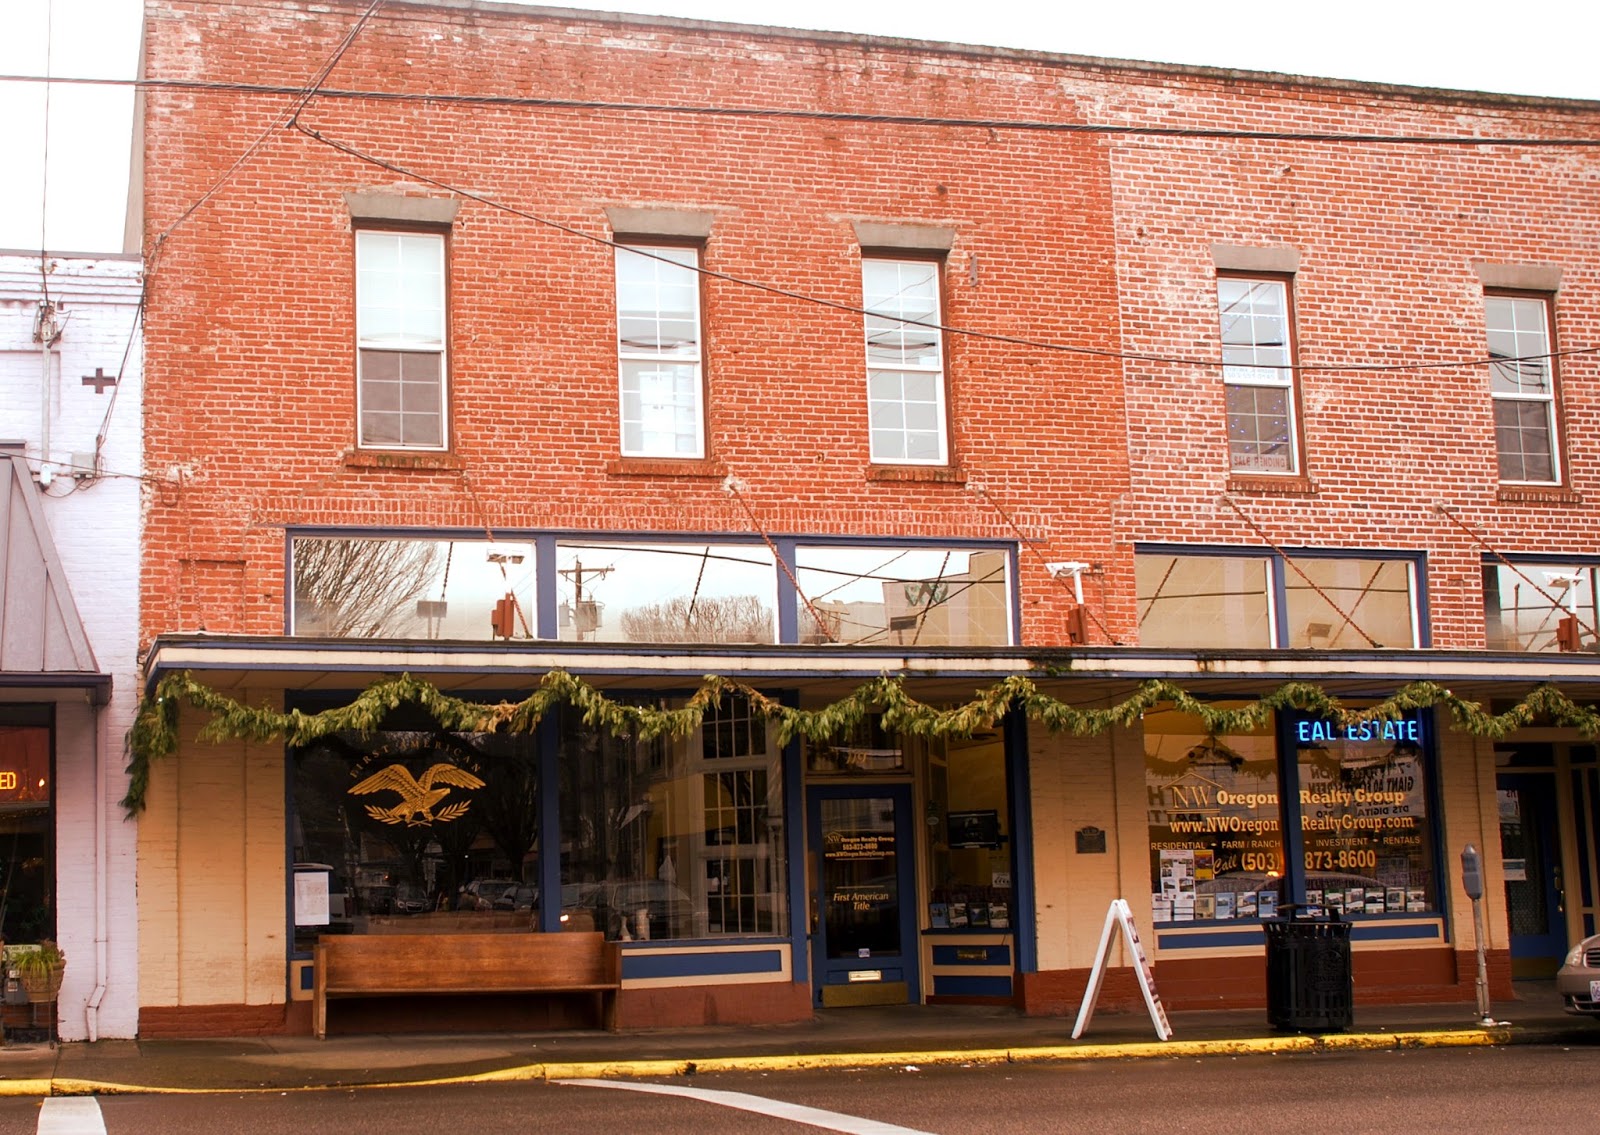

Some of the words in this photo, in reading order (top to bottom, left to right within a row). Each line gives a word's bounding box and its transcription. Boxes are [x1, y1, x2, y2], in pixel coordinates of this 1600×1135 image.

[1234, 455, 1250, 466] SALE
[1254, 456, 1285, 467] PENDING
[1299, 721, 1336, 741] EAL
[350, 744, 389, 778] FIRST
[398, 740, 481, 772] AMERICAN
[1172, 785, 1212, 808] NW
[1216, 790, 1278, 808] Oregon
[1299, 789, 1351, 807] Realty
[1354, 788, 1405, 806] Group
[1169, 816, 1279, 835] www.NWOregon
[1301, 814, 1414, 834] RealtyGroup.com
[1150, 841, 1206, 850] RESIDENTIAL
[1221, 840, 1245, 849] FARM
[1251, 840, 1280, 848] RANCH
[1316, 837, 1368, 847] INVESTMENT
[1383, 835, 1420, 845] RENTALS
[1213, 854, 1238, 875] Call
[1240, 852, 1281, 871] (503)
[1304, 849, 1377, 869] 873-8600
[833, 892, 850, 901] First
[851, 892, 889, 901] American
[853, 901, 870, 910] Title
